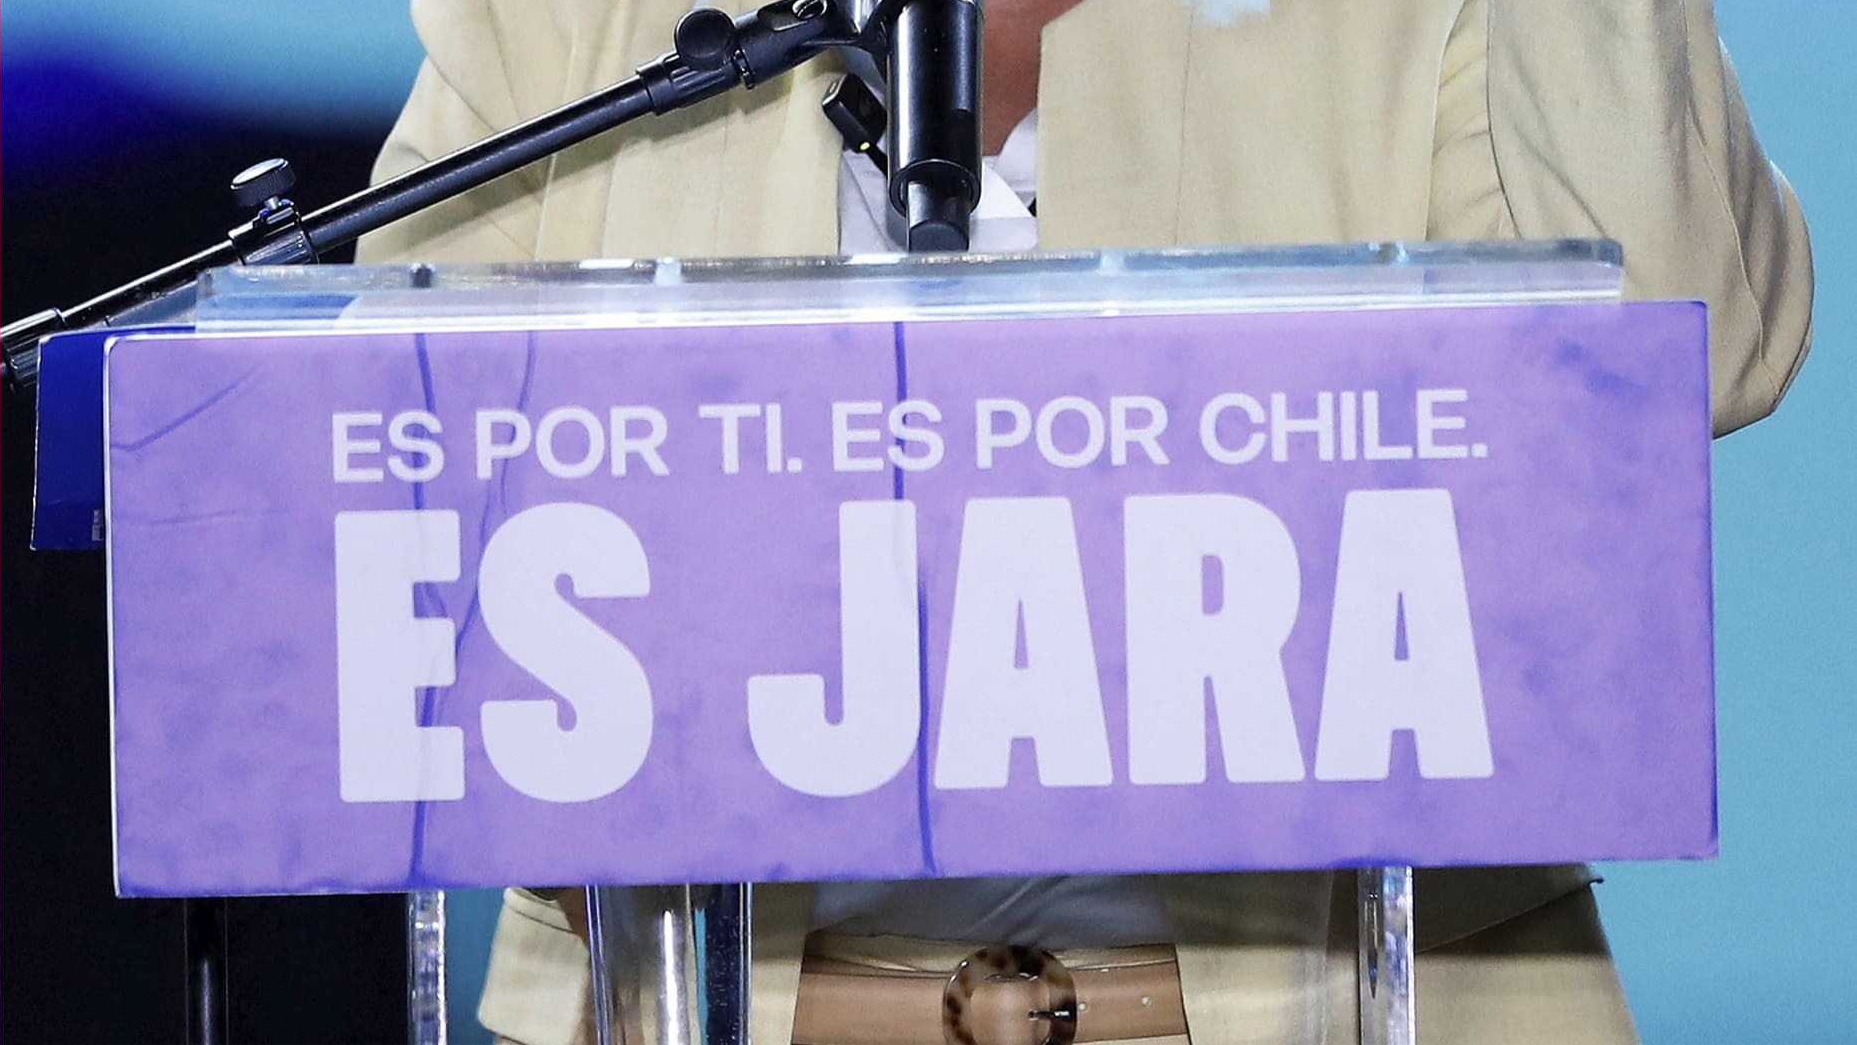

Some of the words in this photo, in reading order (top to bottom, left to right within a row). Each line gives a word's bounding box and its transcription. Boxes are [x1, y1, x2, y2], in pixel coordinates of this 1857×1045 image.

[332, 412, 444, 482] ES
[475, 406, 670, 480] POR
[698, 402, 803, 474] TI.
[831, 399, 945, 472] ES
[975, 395, 1170, 469] POR
[1199, 389, 1488, 465] CHILE.
[335, 502, 653, 803] ES
[747, 488, 1494, 797] JARA
